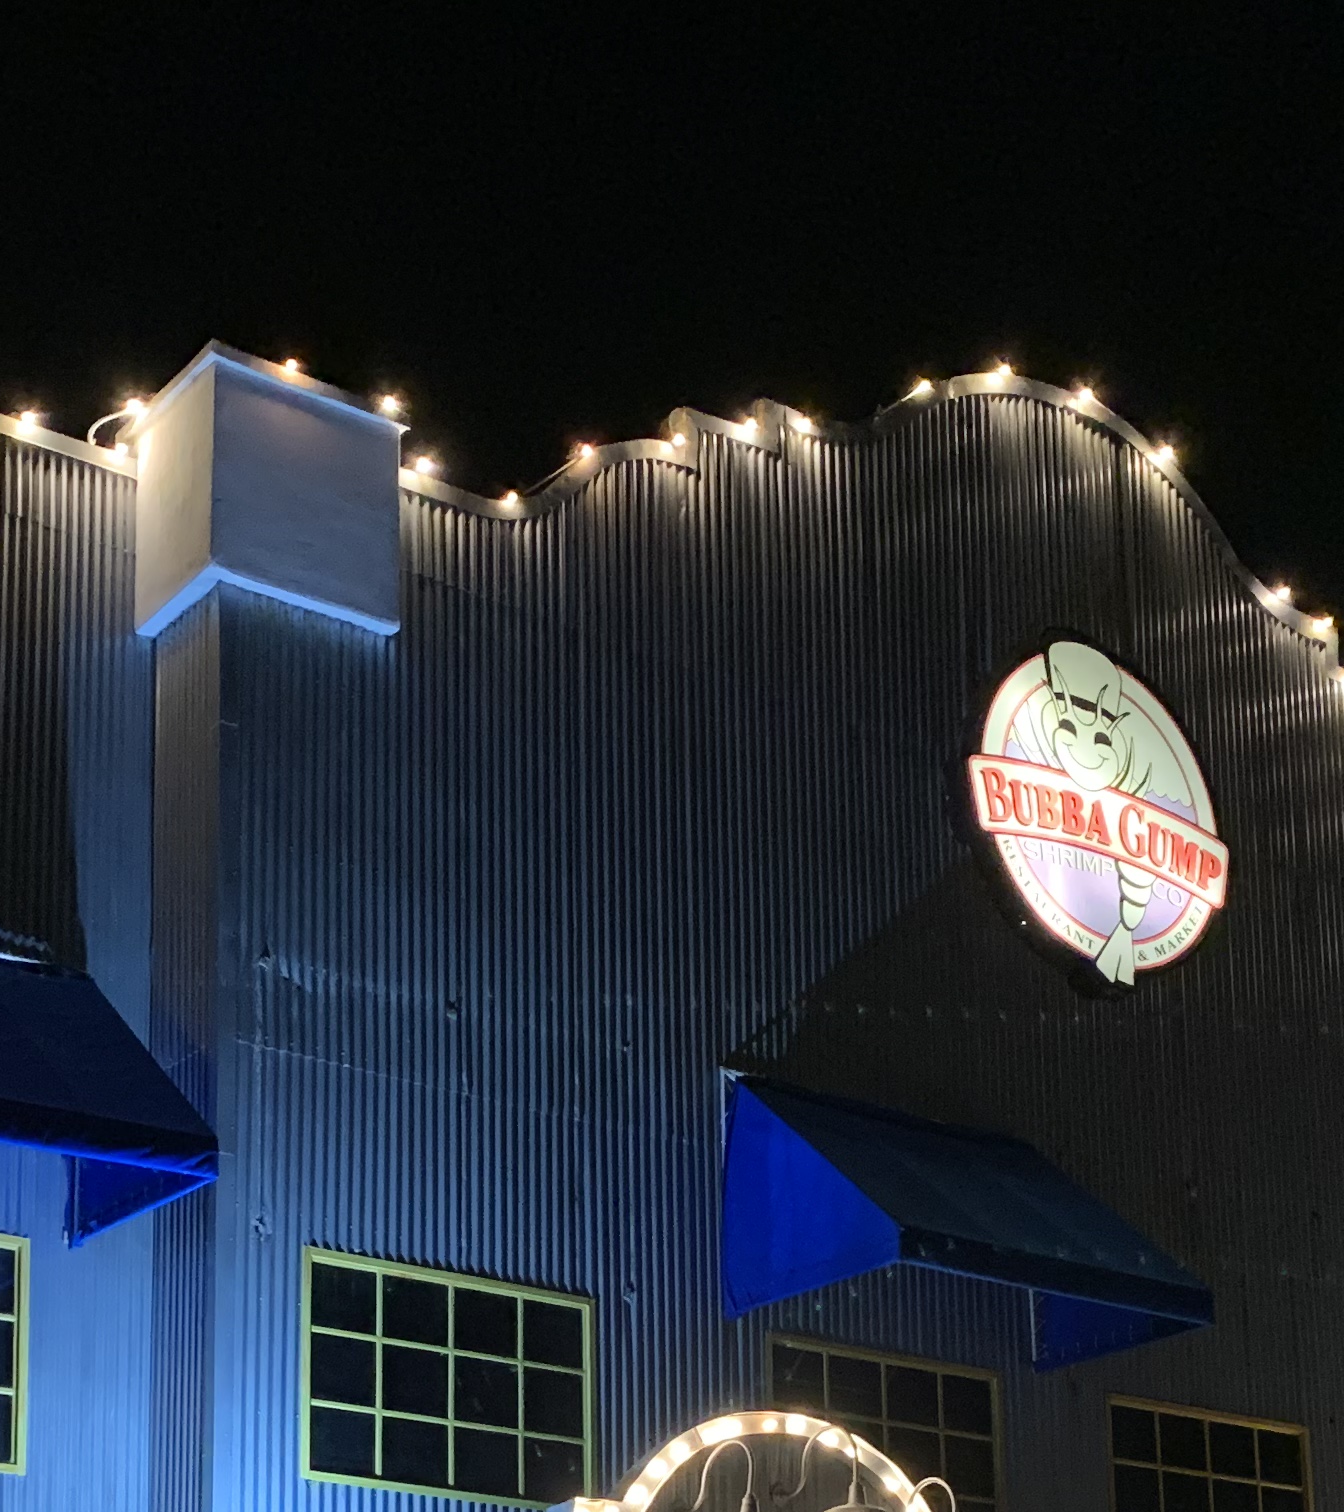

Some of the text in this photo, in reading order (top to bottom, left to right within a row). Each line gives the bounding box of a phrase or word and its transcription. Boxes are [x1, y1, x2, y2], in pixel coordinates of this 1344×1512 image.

[980, 766, 1223, 892] BUBBA GUMP
[1021, 839, 1114, 878] SHRIMP
[1153, 904, 1204, 958] MARKET
